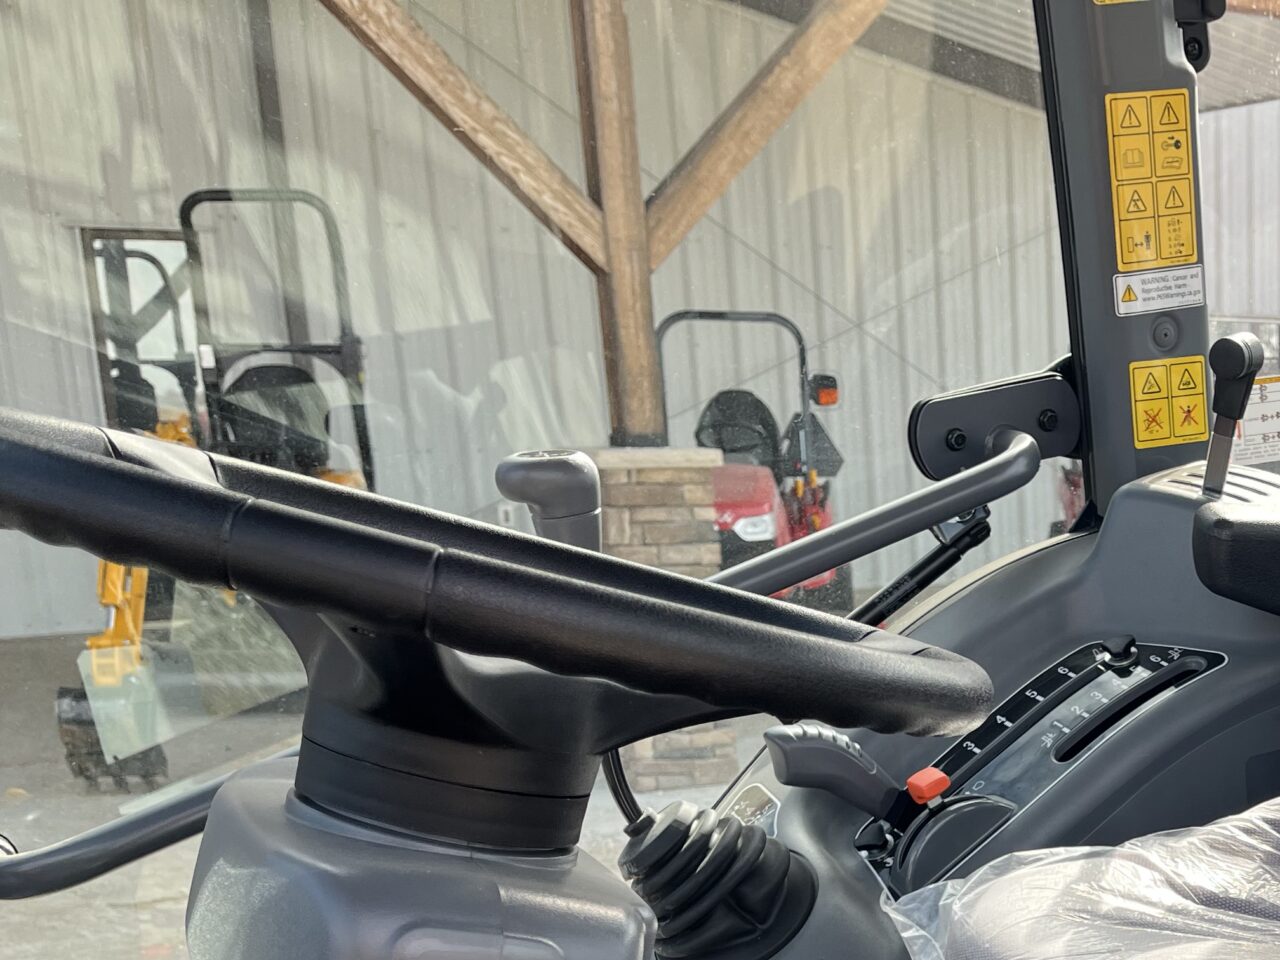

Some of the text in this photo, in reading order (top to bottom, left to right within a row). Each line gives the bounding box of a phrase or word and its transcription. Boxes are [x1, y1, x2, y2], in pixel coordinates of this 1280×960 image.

[1025, 689, 1038, 699] 5
[995, 714, 1007, 725] 4
[962, 741, 975, 751] 3
